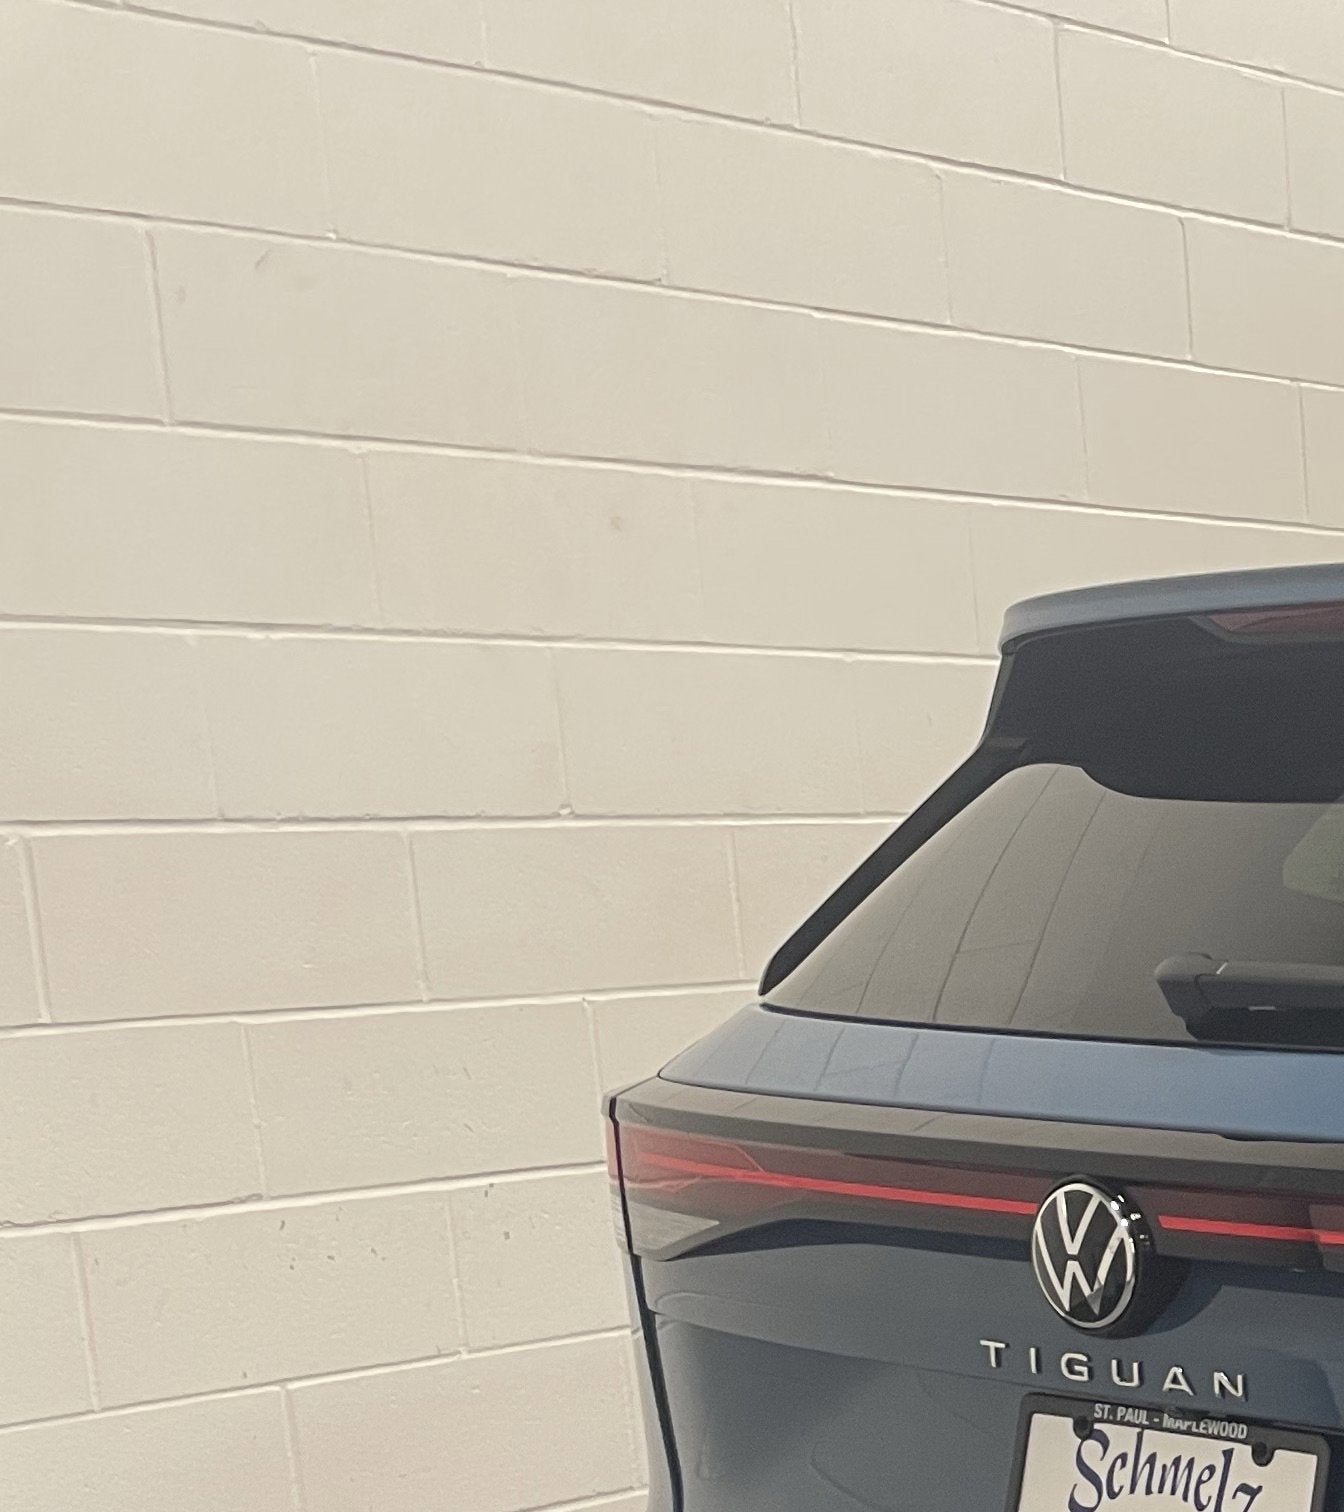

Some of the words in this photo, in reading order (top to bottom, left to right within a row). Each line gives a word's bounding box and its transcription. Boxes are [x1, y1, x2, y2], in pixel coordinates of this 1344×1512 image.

[980, 1339, 1244, 1397] TIGUAN
[1094, 1403, 1113, 1420] ST.
[1117, 1407, 1149, 1425] PAUL
